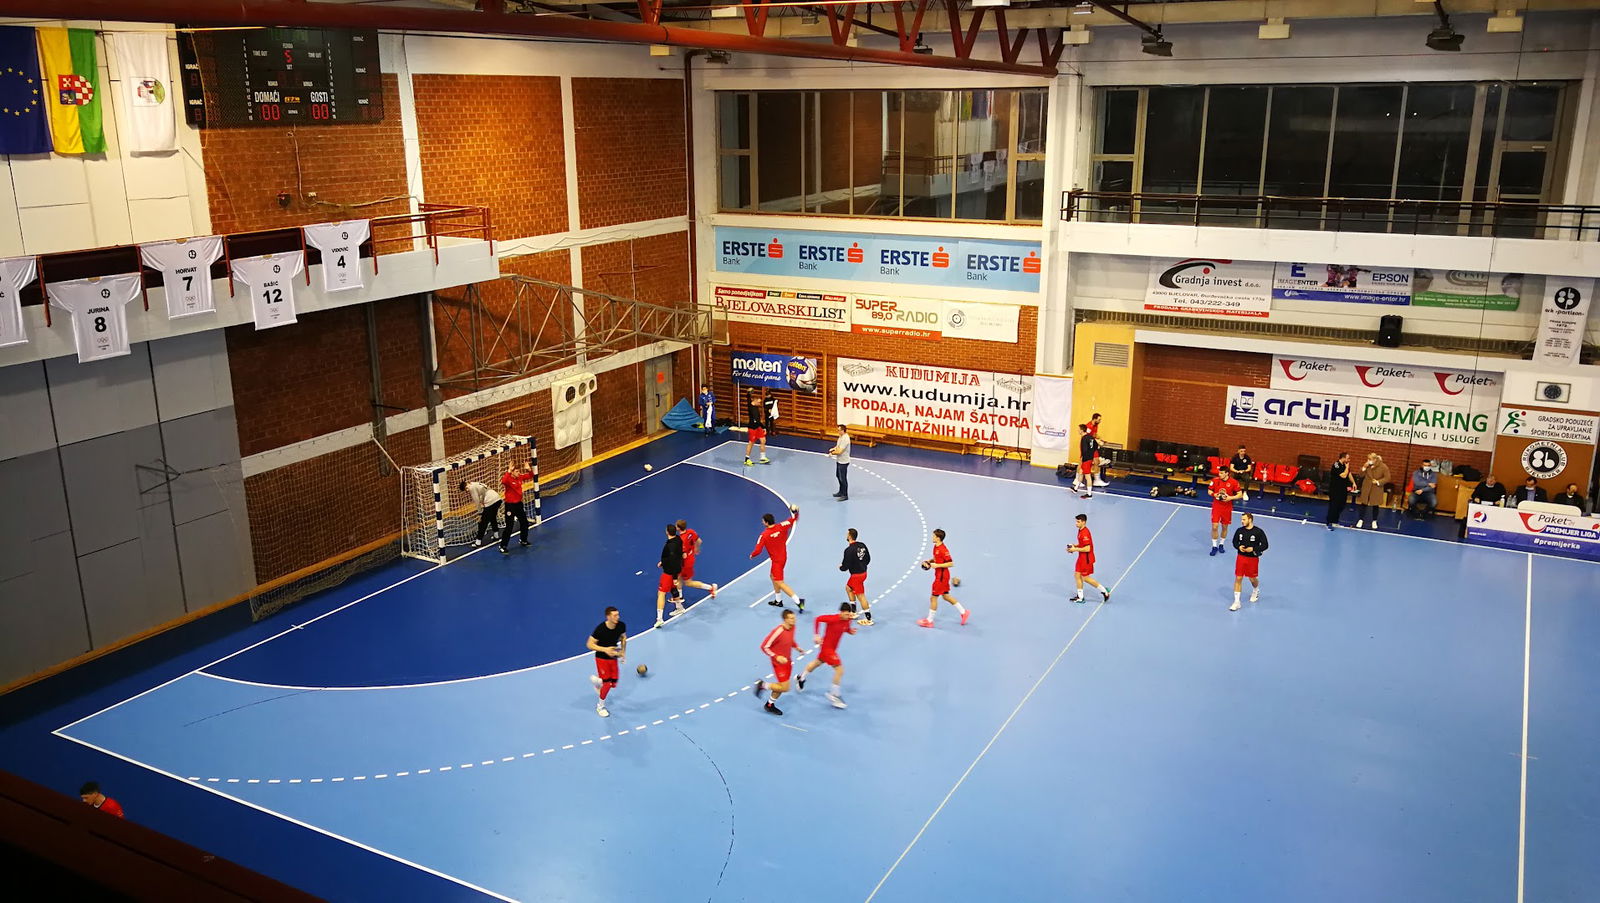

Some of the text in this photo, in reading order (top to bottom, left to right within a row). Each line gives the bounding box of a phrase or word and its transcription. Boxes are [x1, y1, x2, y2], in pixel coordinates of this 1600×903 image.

[255, 90, 280, 102] DOMAĆI
[311, 92, 328, 103] GOSTI
[262, 104, 280, 120] 00
[312, 104, 328, 119] 00
[723, 241, 766, 257] ERSTE
[799, 245, 845, 262] ERSTE
[337, 255, 346, 268] 4
[723, 257, 741, 265] Bank
[881, 250, 929, 266] ERSTE
[967, 254, 1019, 272] ERSTE
[799, 262, 817, 270] Bank
[880, 267, 900, 275] Bank
[182, 276, 193, 291] 7
[967, 272, 987, 281] Bank
[1175, 275, 1210, 287] Gradnja
[1213, 277, 1242, 286] invest
[1372, 273, 1409, 283] EPSON
[263, 289, 283, 304] 12
[1190, 299, 1240, 307] 043/222-349
[856, 299, 897, 312] SUPER
[94, 316, 107, 332] 8
[872, 310, 938, 324] 89,0 RADIO
[862, 326, 931, 338] www.superradio.hr
[733, 358, 781, 373] molten
[885, 365, 981, 386] KUDUMIJA
[843, 382, 1031, 411] www.kudumija.hr
[843, 397, 1030, 429] PRODAJA, NAJAM ŠATORA
[1264, 398, 1350, 427] artik
[1364, 404, 1488, 432] DEMARING
[875, 416, 956, 438] MONTAŽNIH
[961, 427, 999, 442] HALA
[1565, 418, 1593, 426] PODUZEĆE
[1366, 426, 1428, 439] INŽENJERNG
[1442, 434, 1480, 444] USLUGE
[1531, 428, 1560, 438] ŠPORTSKIM
[1557, 425, 1592, 434] UPRAVLJANJE
[1546, 527, 1596, 538] PREMIJER LIGA
[1534, 538, 1580, 550] #premijerka
